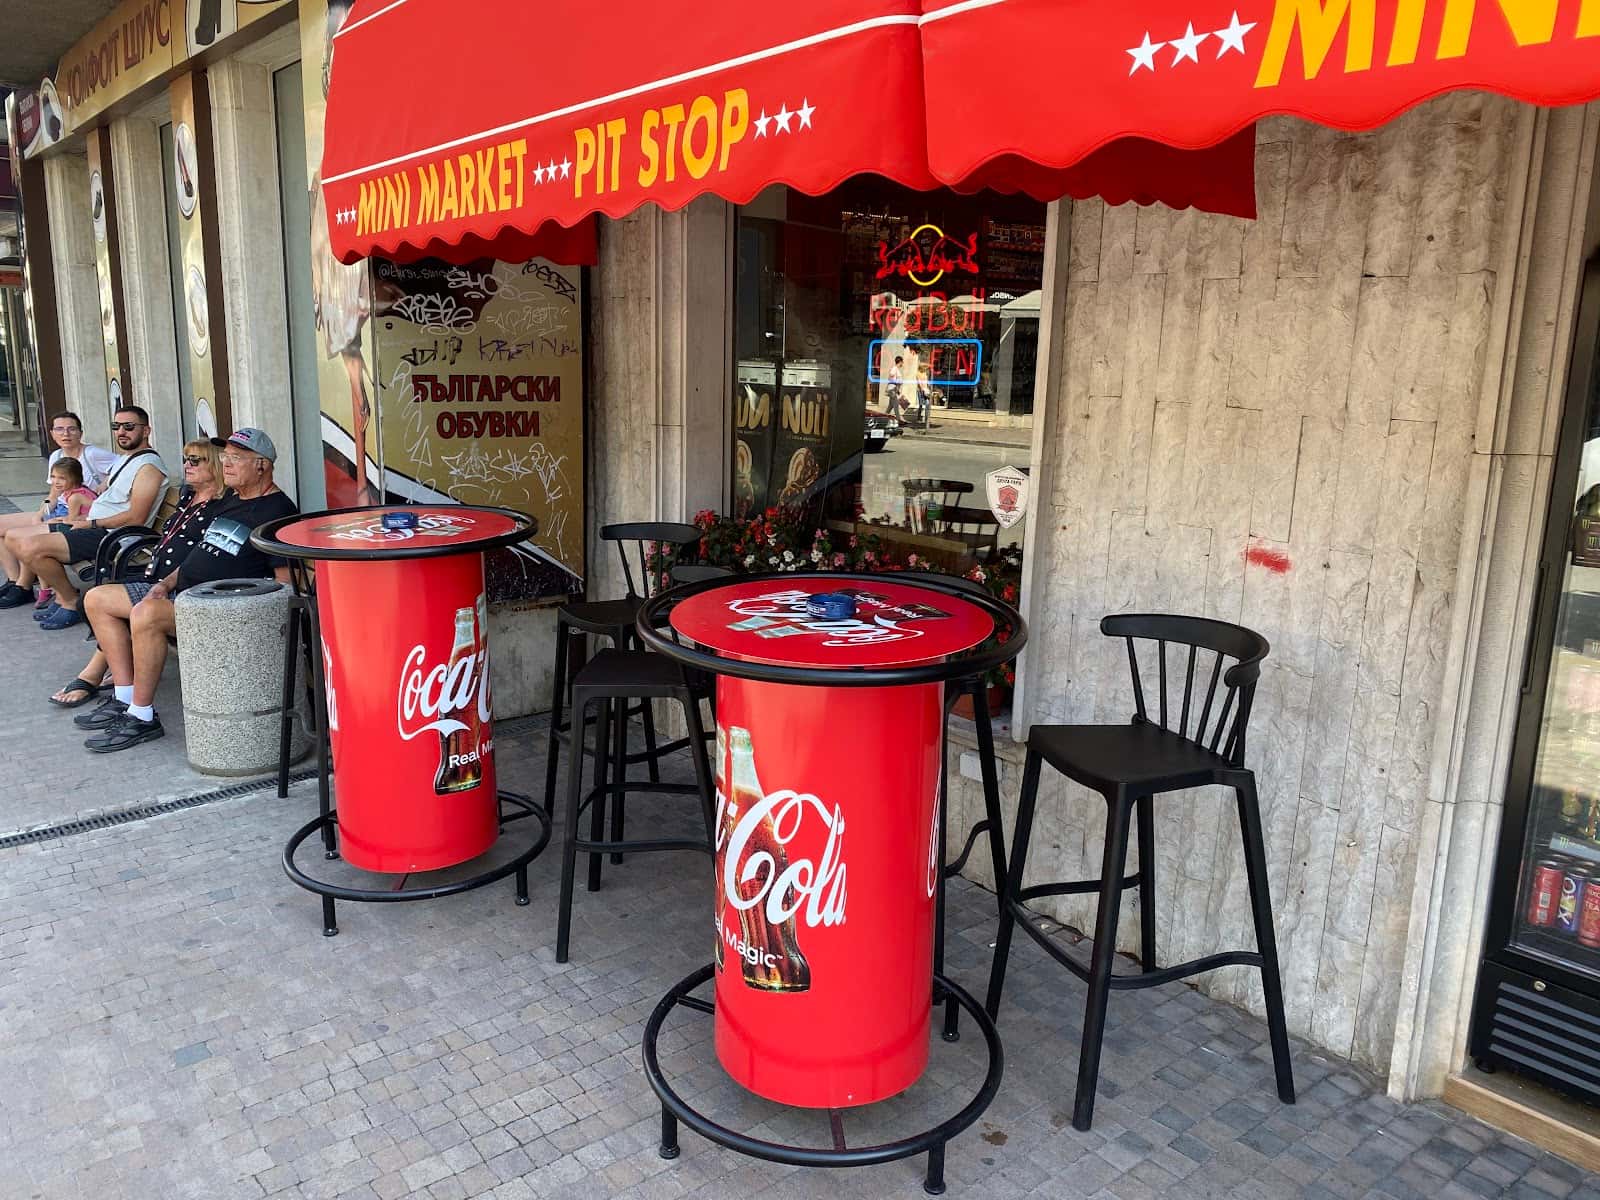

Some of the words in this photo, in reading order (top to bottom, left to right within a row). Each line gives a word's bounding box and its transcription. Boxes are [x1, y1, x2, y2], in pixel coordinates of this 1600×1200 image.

[356, 168, 410, 237] MINI
[416, 138, 528, 226] MARKET
[574, 117, 627, 198] PIT
[638, 87, 750, 188] STOP
[869, 290, 921, 332] Red
[928, 287, 985, 333] Bull
[412, 375, 560, 402] БЪЛГАРСКИ
[436, 411, 540, 439] ОБУВКИ
[449, 745, 480, 768] Real
